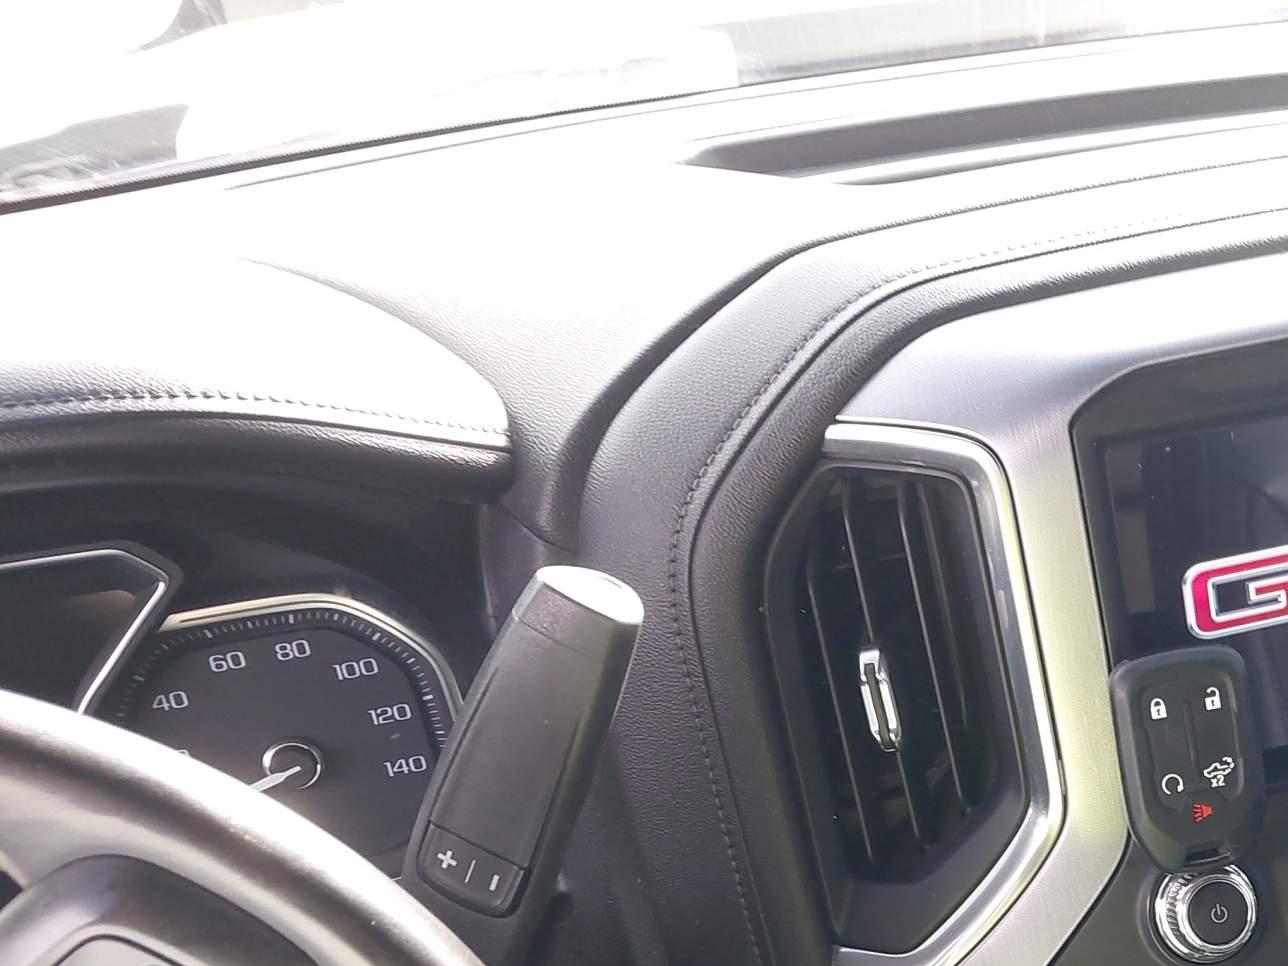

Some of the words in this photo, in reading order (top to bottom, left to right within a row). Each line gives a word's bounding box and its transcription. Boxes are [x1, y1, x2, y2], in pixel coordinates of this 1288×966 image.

[275, 639, 312, 662] 80
[208, 651, 247, 673] 60
[332, 658, 380, 681] 100
[151, 690, 190, 711] 40
[367, 704, 413, 726] 120
[383, 755, 428, 778] 140
[1210, 774, 1226, 788] x2
